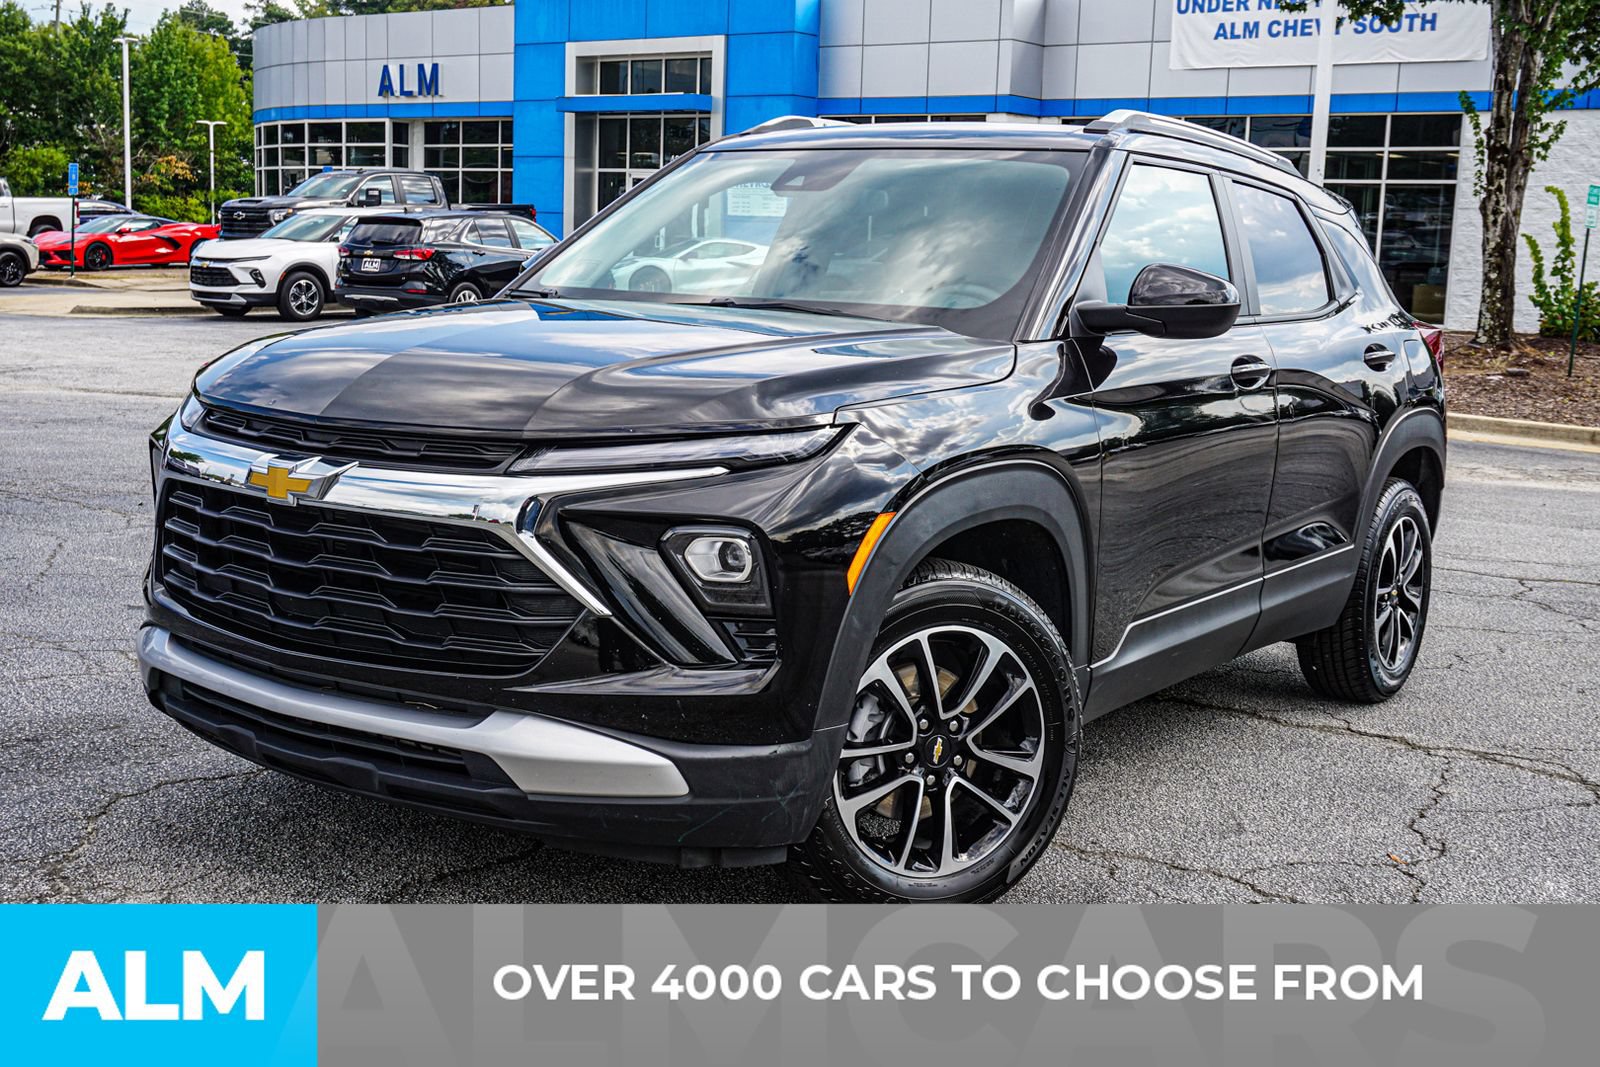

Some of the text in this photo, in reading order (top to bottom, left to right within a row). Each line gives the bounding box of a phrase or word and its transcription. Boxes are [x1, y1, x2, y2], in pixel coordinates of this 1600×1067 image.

[1176, 0, 1251, 14] UNDER
[1213, 21, 1260, 40] ALM
[1353, 13, 1438, 35] SOUTH
[378, 63, 440, 97] ALM
